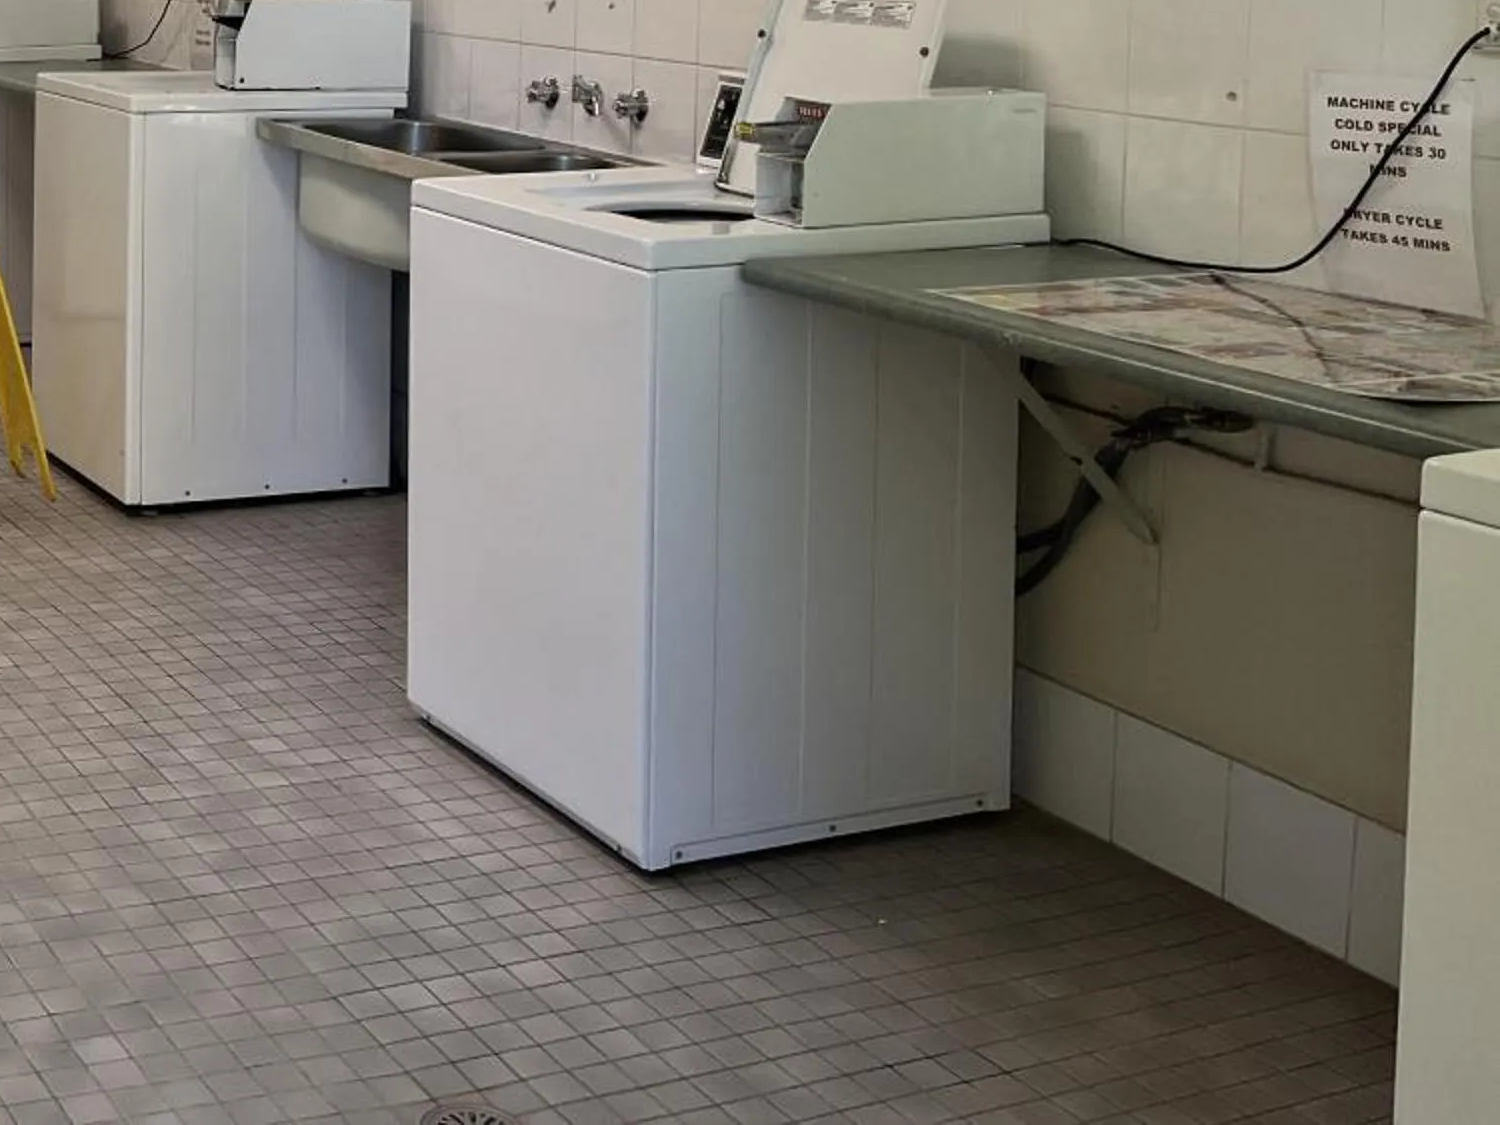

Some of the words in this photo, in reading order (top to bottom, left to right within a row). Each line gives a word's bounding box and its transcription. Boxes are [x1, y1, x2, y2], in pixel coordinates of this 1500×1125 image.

[1327, 96, 1395, 112] MACHINE
[1400, 100, 1451, 116] CYLE
[1334, 118, 1374, 132] COLD
[1330, 139, 1369, 153] ONLY
[1428, 147, 1446, 160] 30
[1344, 208, 1391, 224] RYER
[1395, 214, 1443, 230] CYCLE
[1341, 228, 1388, 244] TAKES
[1392, 235, 1409, 247] 45
[1413, 237, 1451, 252] MINS
